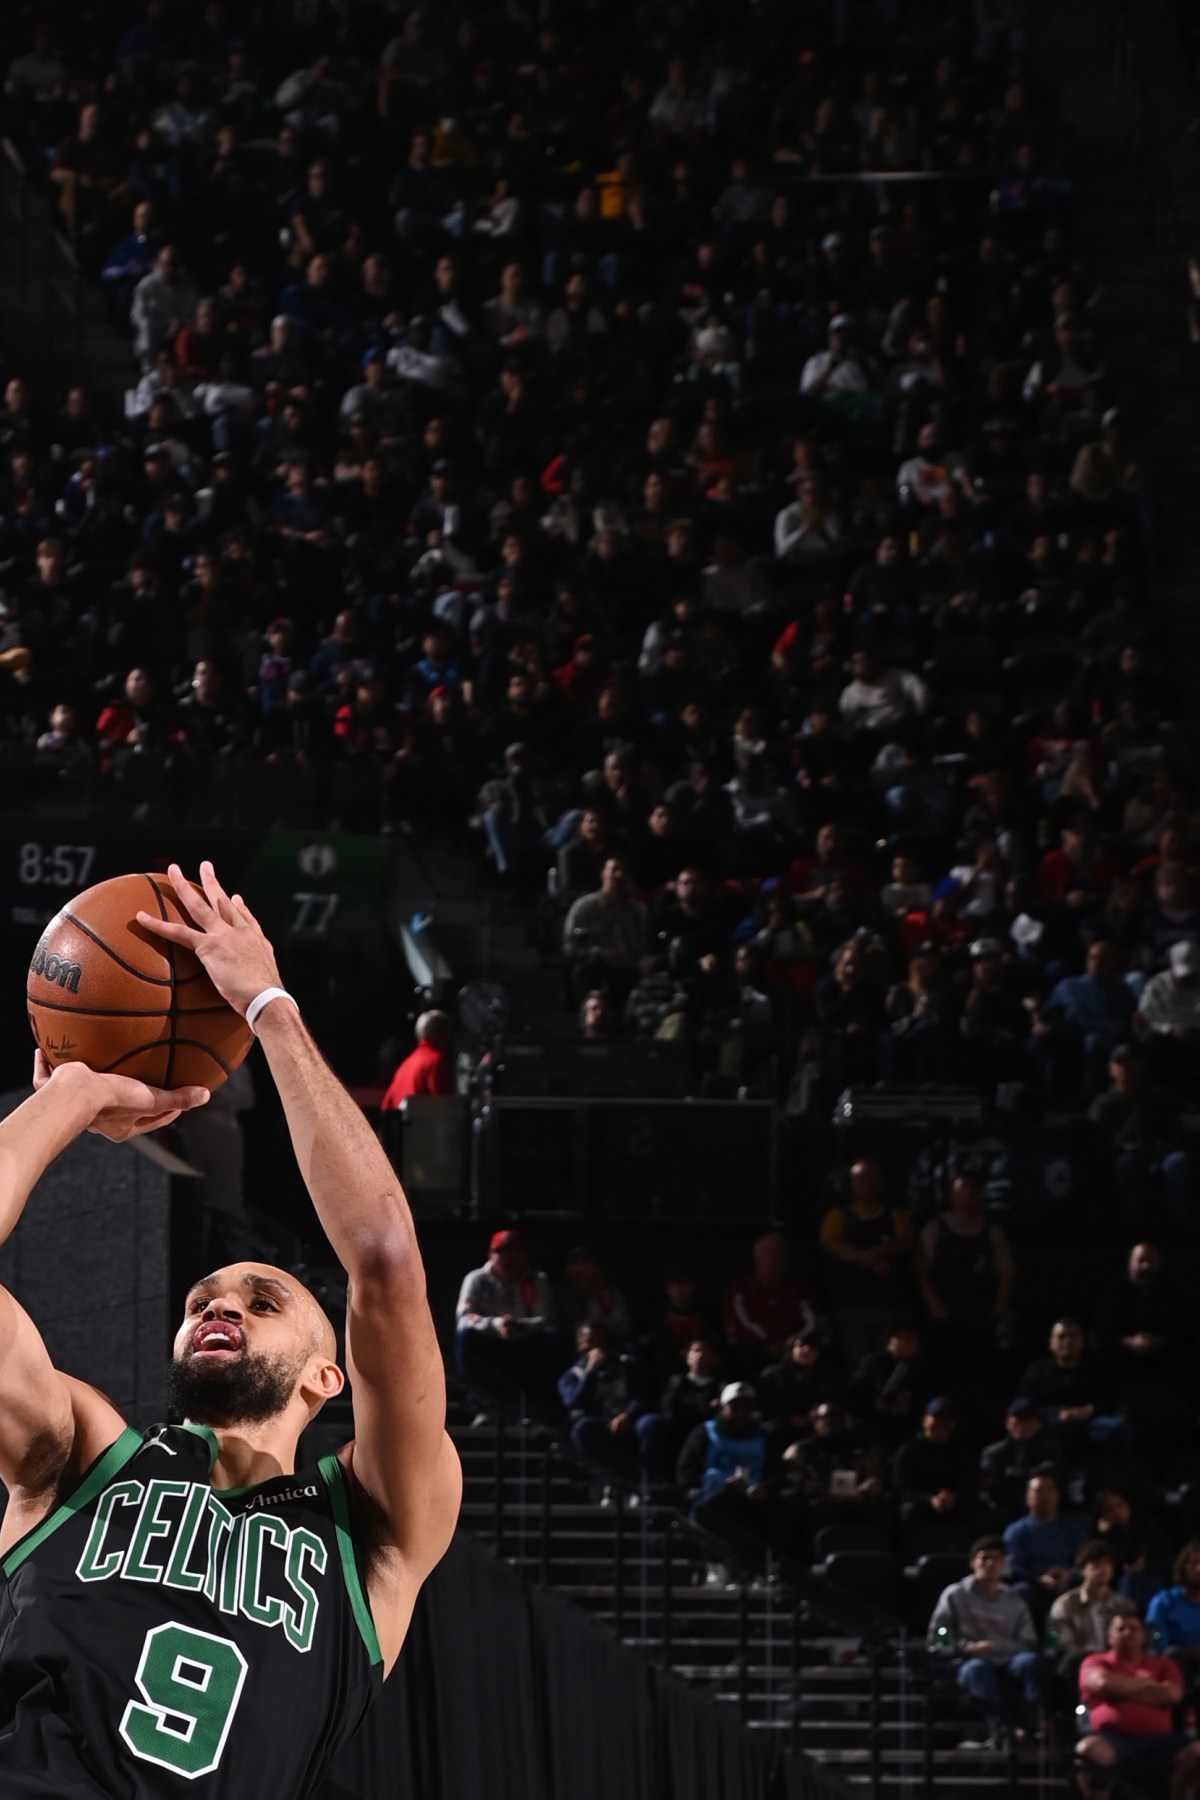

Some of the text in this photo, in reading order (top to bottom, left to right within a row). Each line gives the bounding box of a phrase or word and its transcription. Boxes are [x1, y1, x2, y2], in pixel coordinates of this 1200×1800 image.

[18, 842, 96, 887] 8:57
[291, 892, 339, 938] 77
[245, 1484, 319, 1510] Amica
[75, 1478, 328, 1654] CELTICS
[118, 1620, 249, 1780] 9
